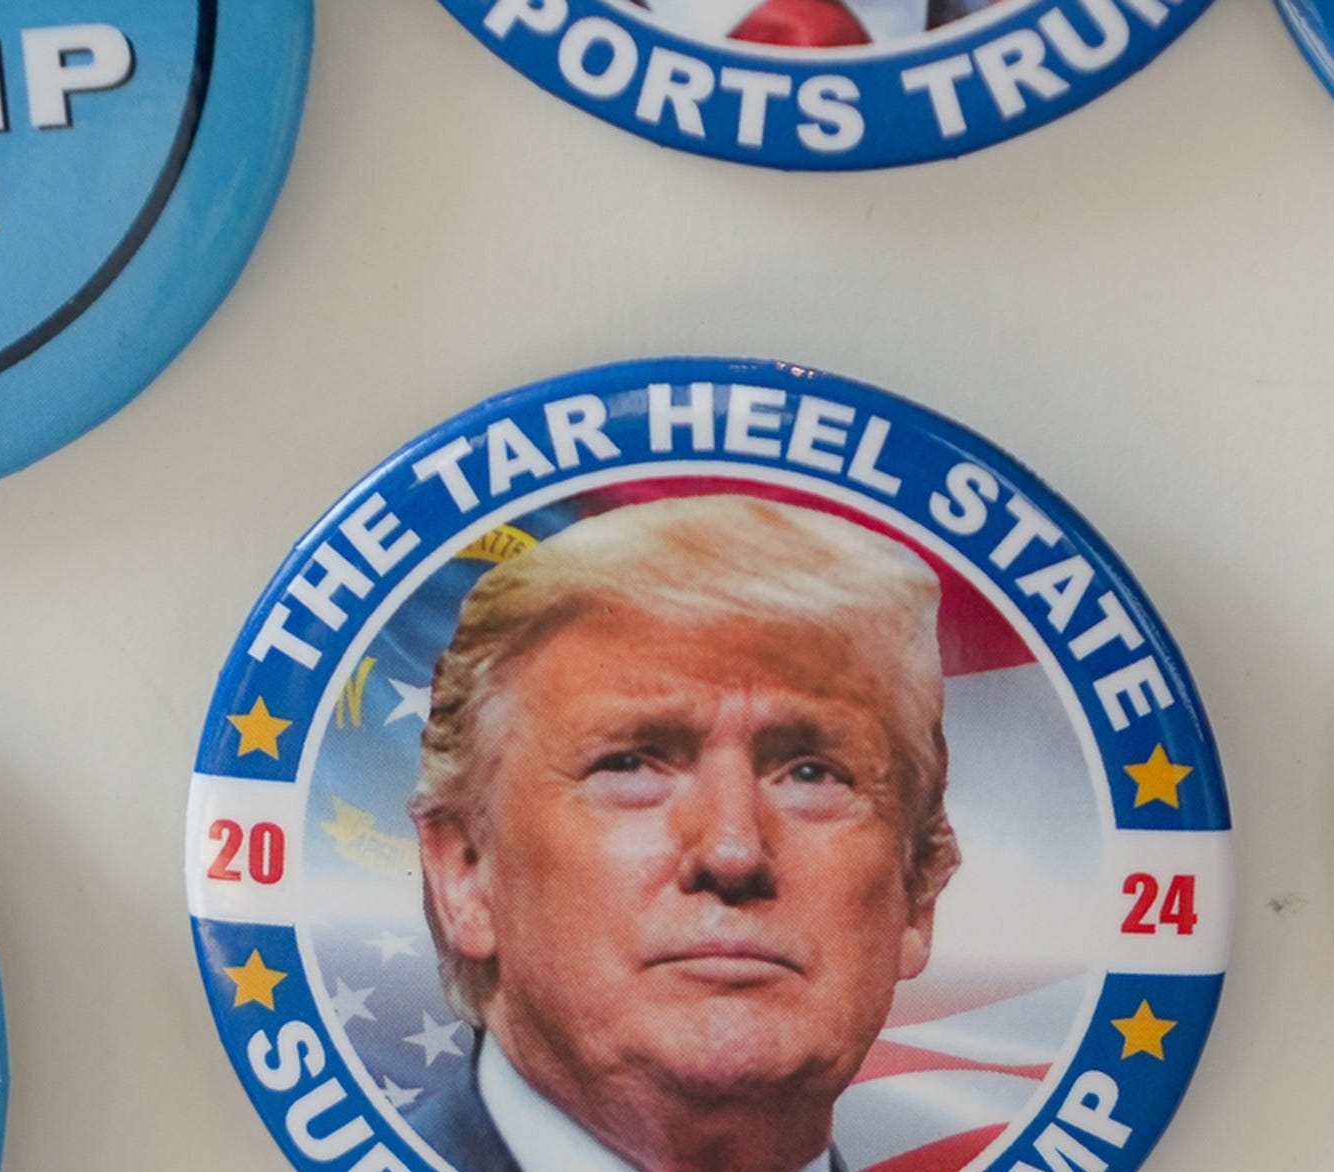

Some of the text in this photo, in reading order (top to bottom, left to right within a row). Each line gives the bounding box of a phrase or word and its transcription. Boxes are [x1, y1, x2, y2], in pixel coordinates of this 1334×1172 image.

[248, 382, 1174, 731] THE TAR HEEL STATE
[206, 819, 287, 884] 20
[1121, 872, 1199, 937] 24
